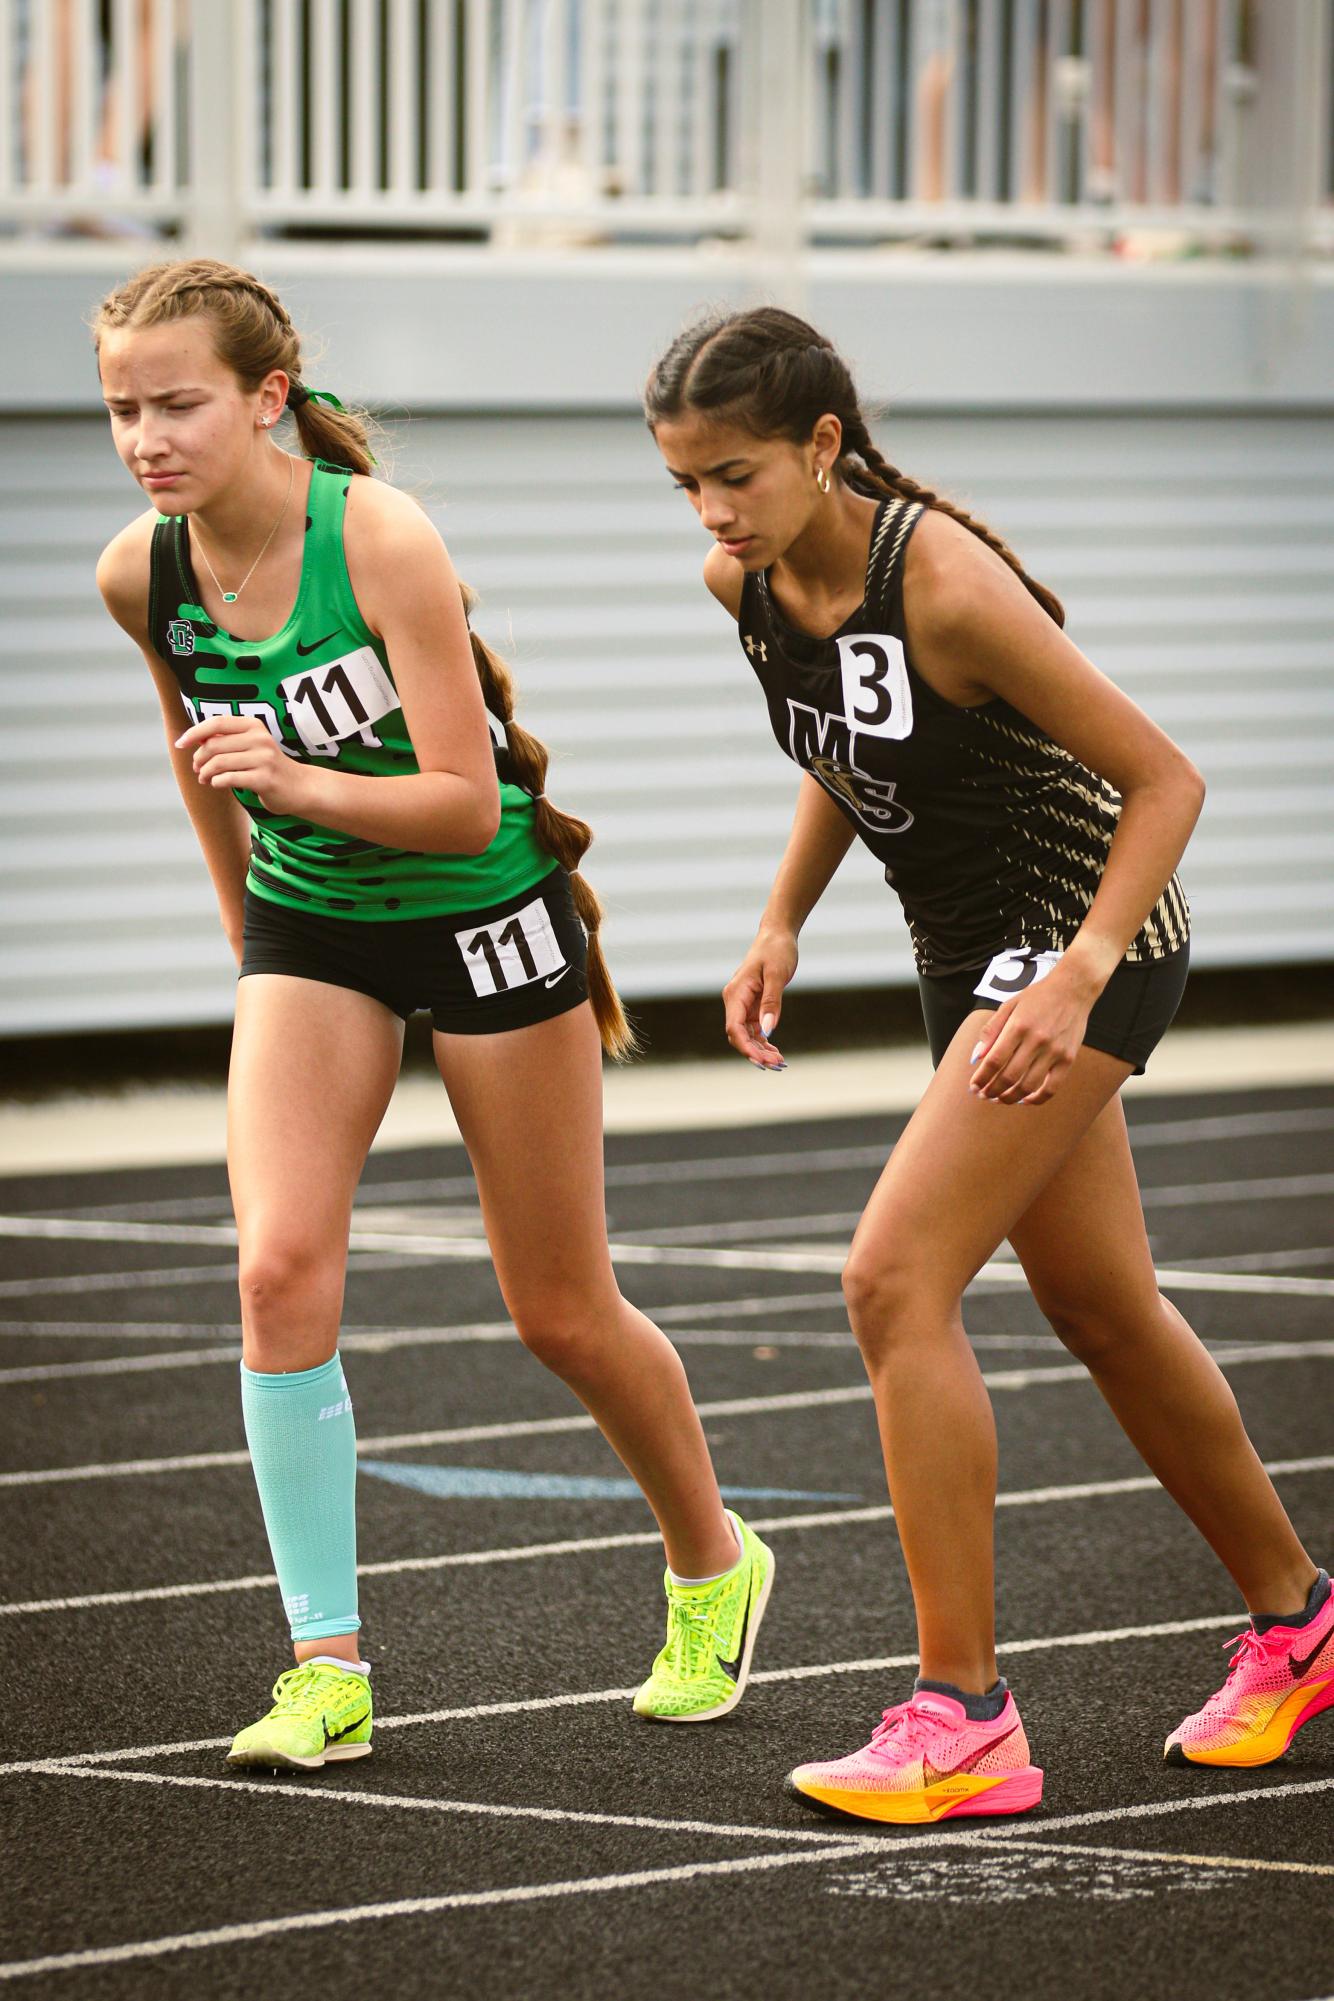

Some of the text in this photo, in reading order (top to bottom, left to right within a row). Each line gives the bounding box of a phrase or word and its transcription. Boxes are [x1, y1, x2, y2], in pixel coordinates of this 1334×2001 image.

[294, 664, 370, 738] 11
[849, 641, 892, 725] 3
[467, 918, 538, 991] 11
